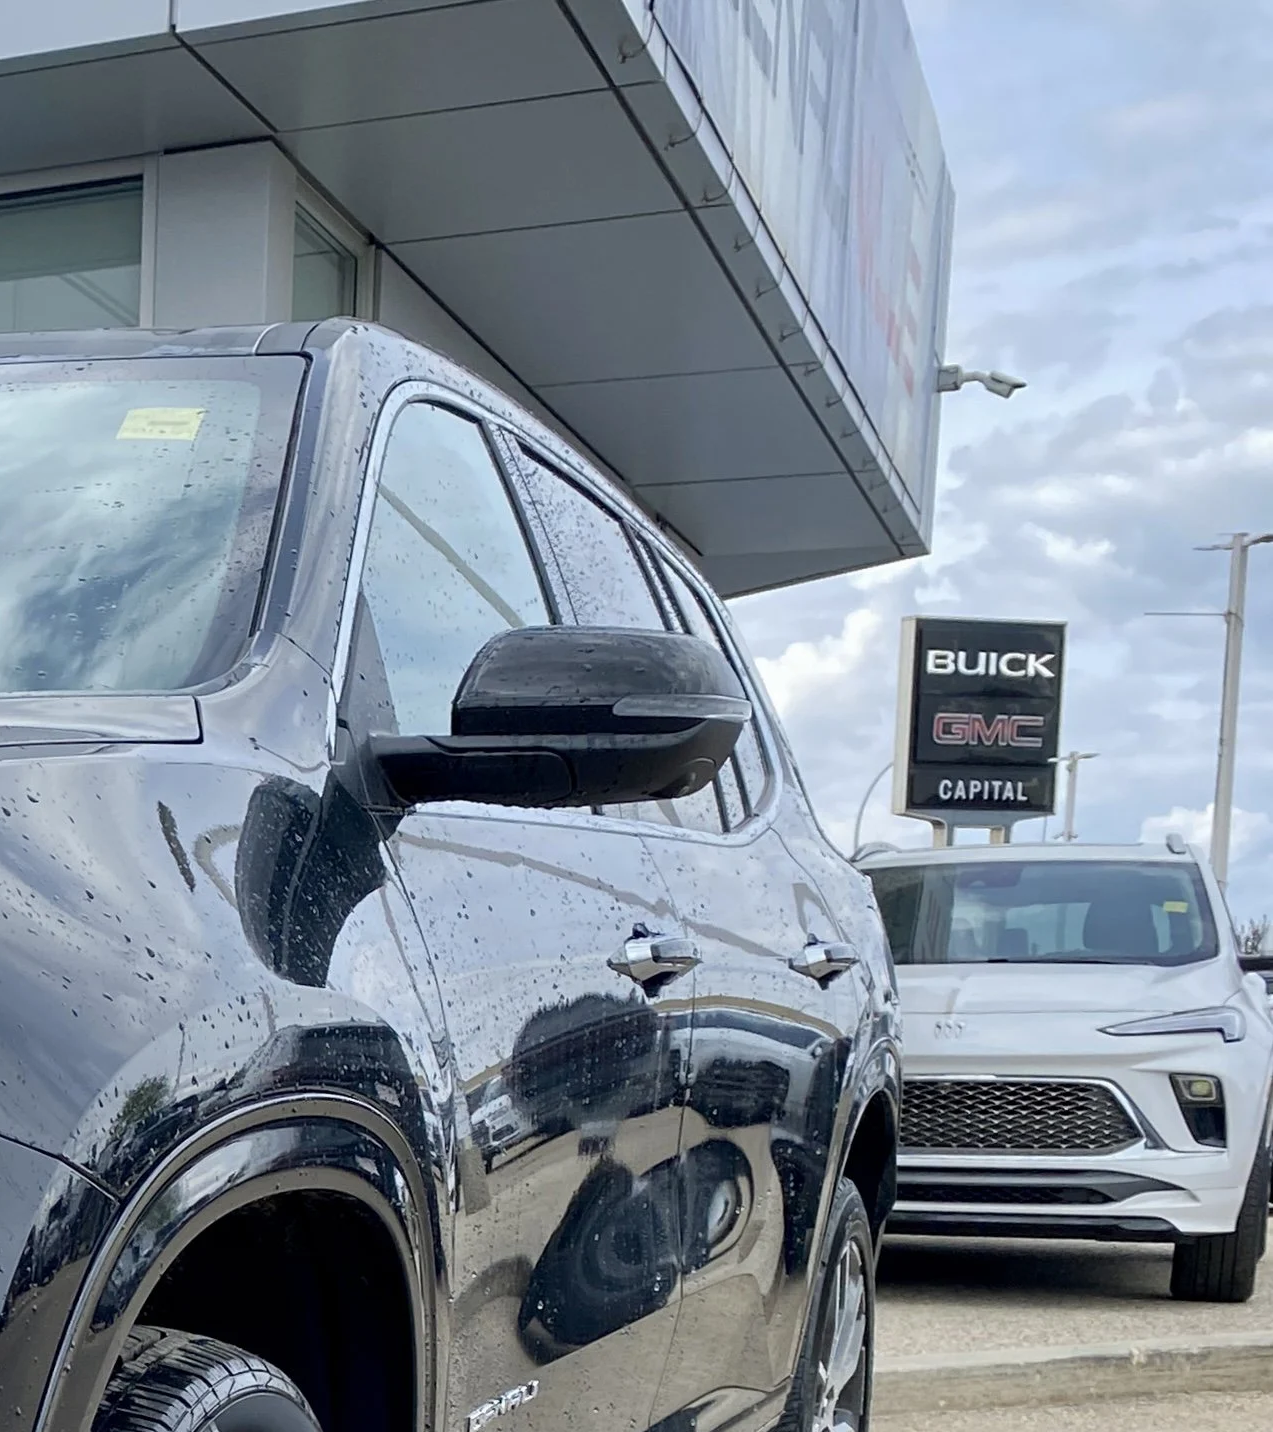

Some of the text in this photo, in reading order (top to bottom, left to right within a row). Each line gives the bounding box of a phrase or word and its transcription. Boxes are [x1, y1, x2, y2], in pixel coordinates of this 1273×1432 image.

[925, 649, 1056, 678] BUICK
[932, 712, 1044, 748] GMC
[938, 779, 1029, 802] CAPITAL
